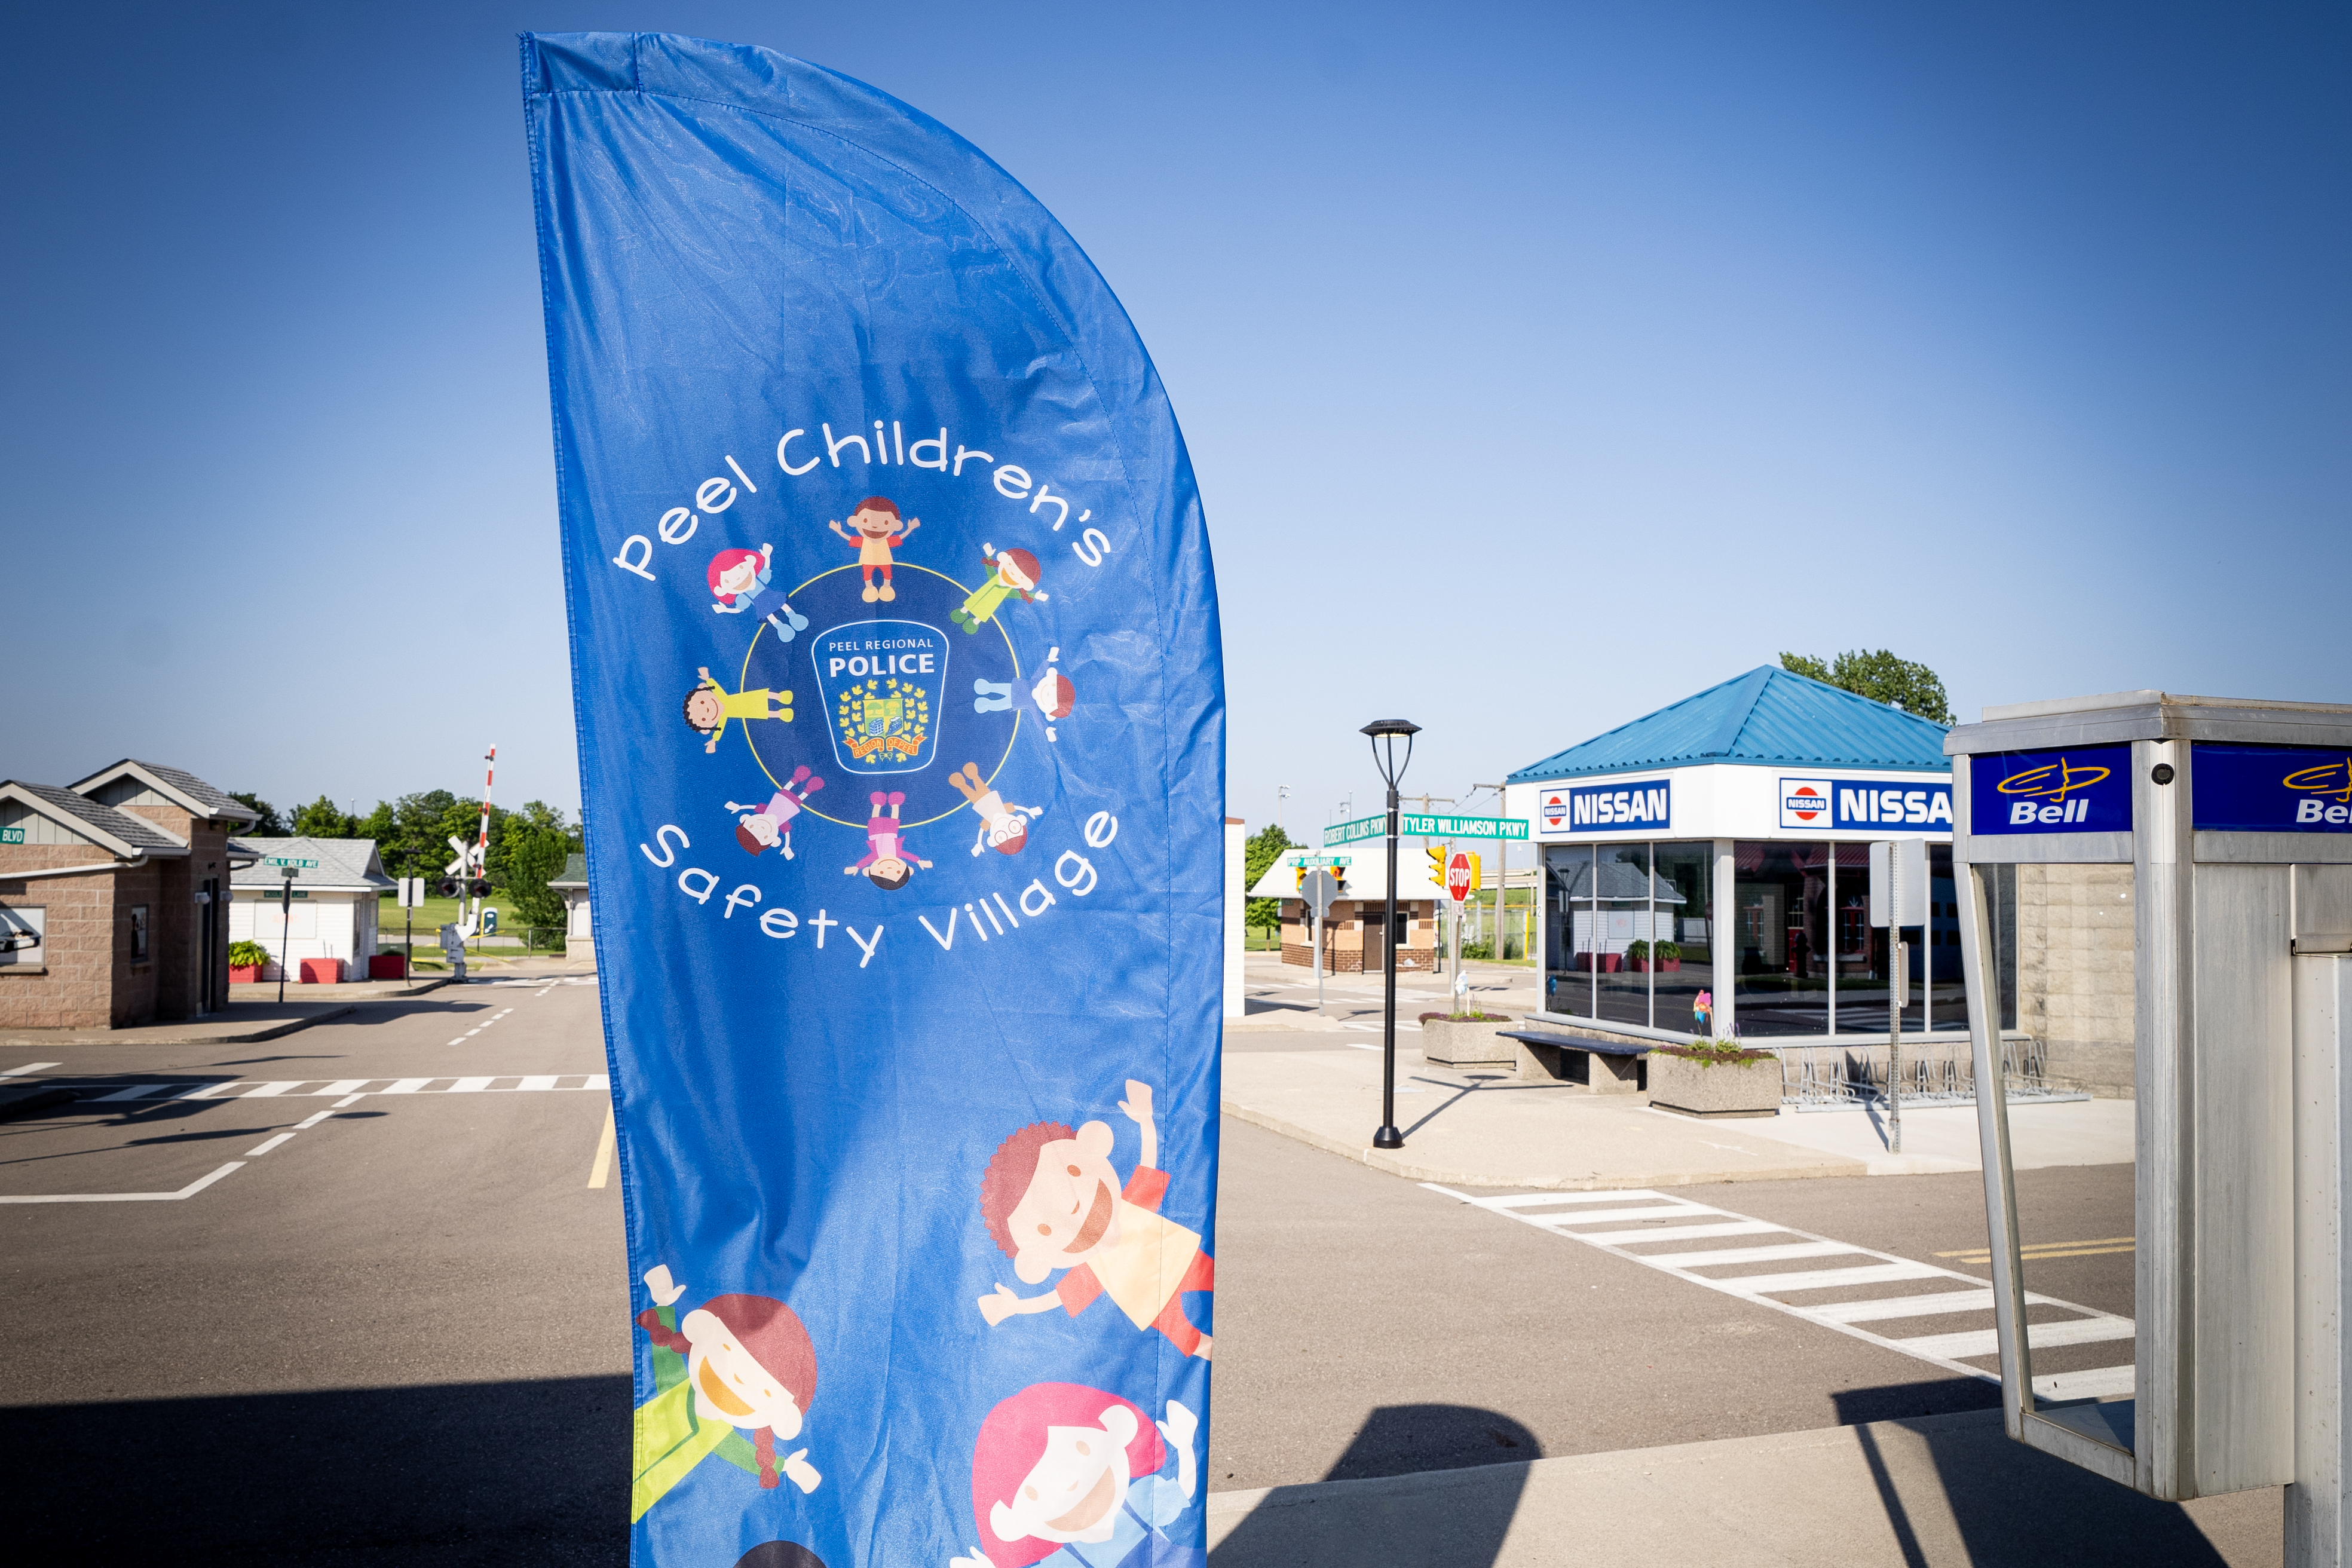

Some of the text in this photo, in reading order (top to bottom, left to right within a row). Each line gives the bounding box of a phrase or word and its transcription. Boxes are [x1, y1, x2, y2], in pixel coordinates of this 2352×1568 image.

[612, 420, 1111, 581] Peel Children's
[829, 638, 933, 652] PEEL REGIONAL
[829, 653, 935, 677] POLICE
[855, 739, 881, 757] REGION
[898, 741, 917, 754] PEEL
[1545, 807, 1566, 816] NISSAN
[1574, 788, 1667, 825] NISSAN
[1788, 798, 1825, 809] NISSAN
[1840, 789, 1953, 824] NISSA
[2010, 799, 2089, 825] Bell
[2296, 799, 2352, 823] Be
[2, 829, 23, 842] BLVD
[1324, 826, 1345, 845] ROBERT
[1346, 820, 1369, 840] COLLINS
[1404, 817, 1526, 837] TYLER WILLIAMSON PKWY
[265, 858, 279, 866] EMIL
[1303, 858, 1336, 866] AUXILIARY
[1450, 868, 1470, 887] STOP
[640, 811, 1118, 969] Safety Village
[1537, 906, 1542, 917] 2
